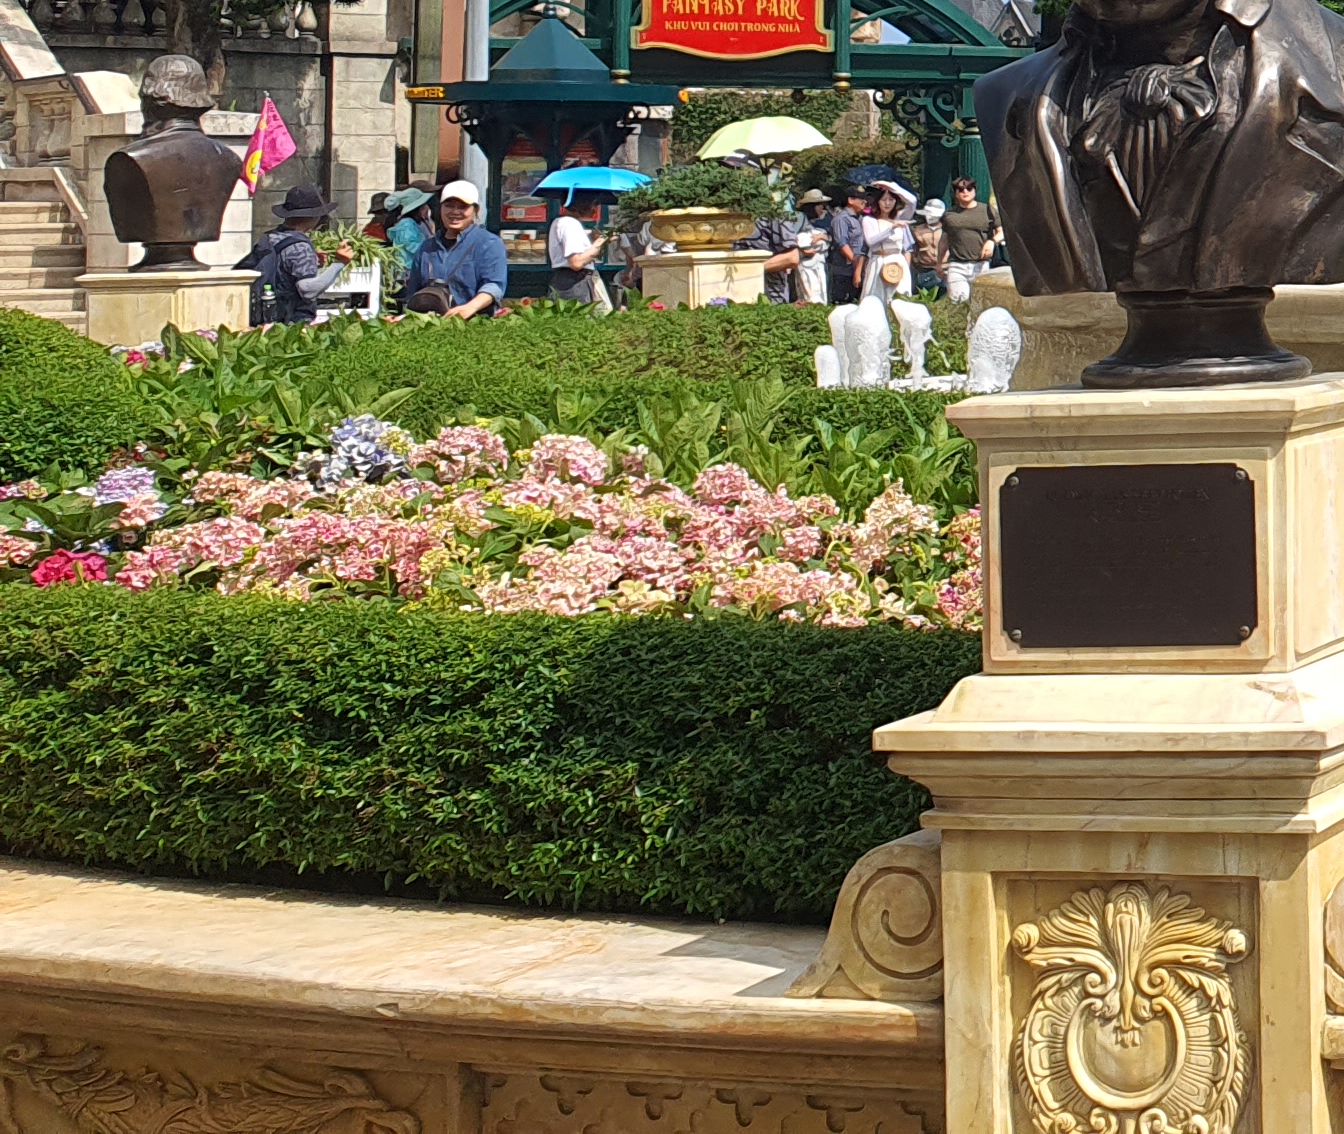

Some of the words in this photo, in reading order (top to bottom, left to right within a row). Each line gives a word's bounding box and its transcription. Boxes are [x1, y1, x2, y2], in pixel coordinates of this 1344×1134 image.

[664, 20, 689, 31] KHU
[690, 21, 710, 31] VUI
[740, 22, 776, 32] TRONG
